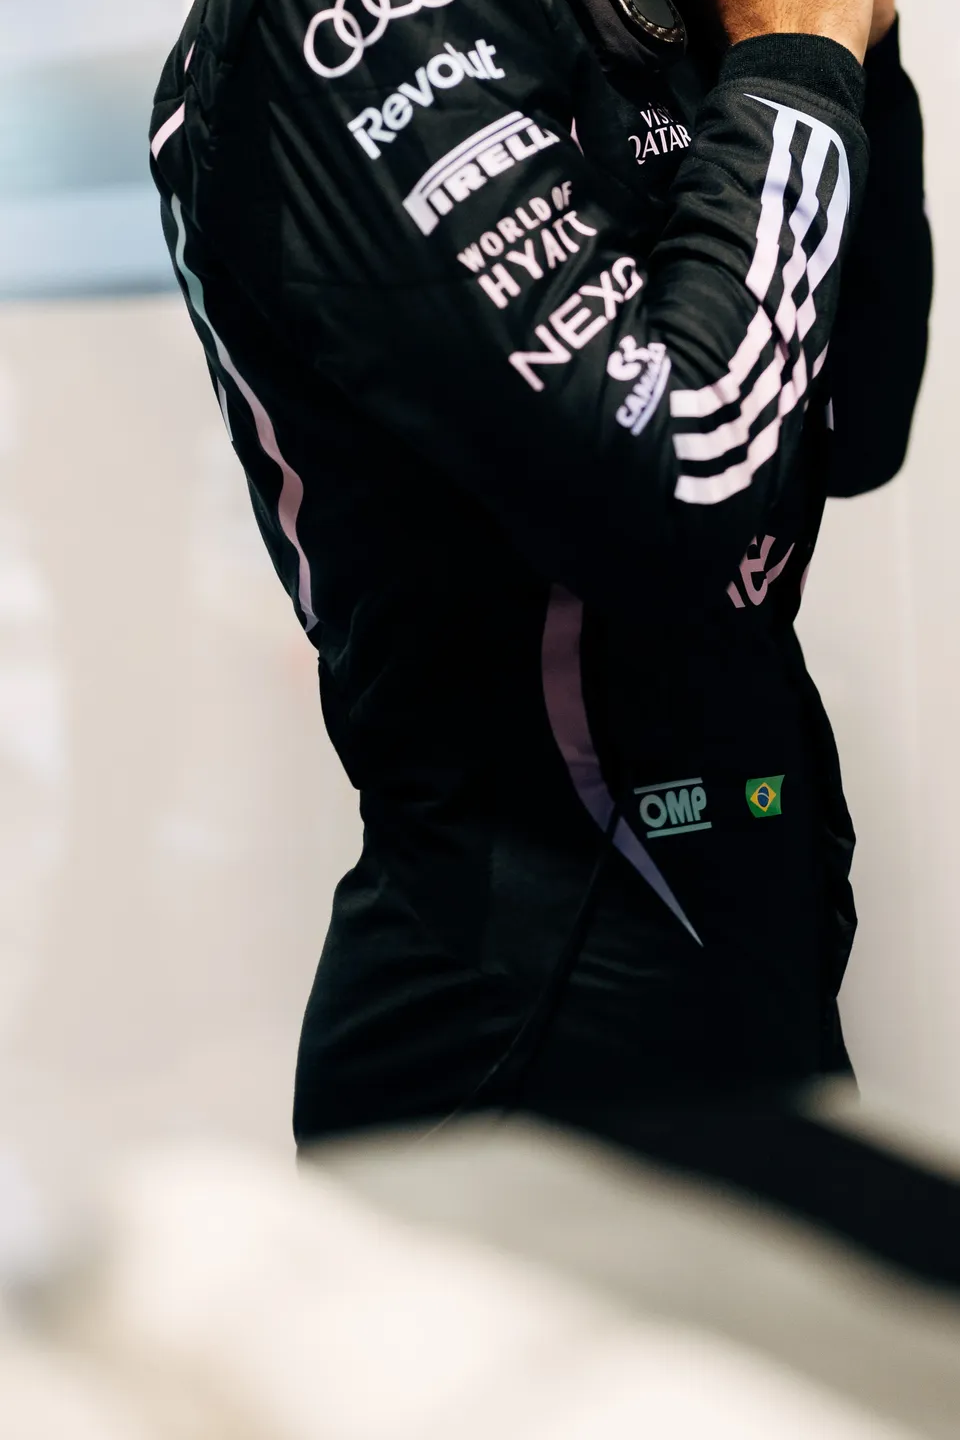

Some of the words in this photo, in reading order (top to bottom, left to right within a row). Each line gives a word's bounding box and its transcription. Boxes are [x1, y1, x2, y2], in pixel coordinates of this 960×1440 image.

[457, 197, 552, 273] WORLD
[551, 180, 572, 211] OF
[477, 210, 598, 309] HYATT
[639, 786, 707, 828] OMP
